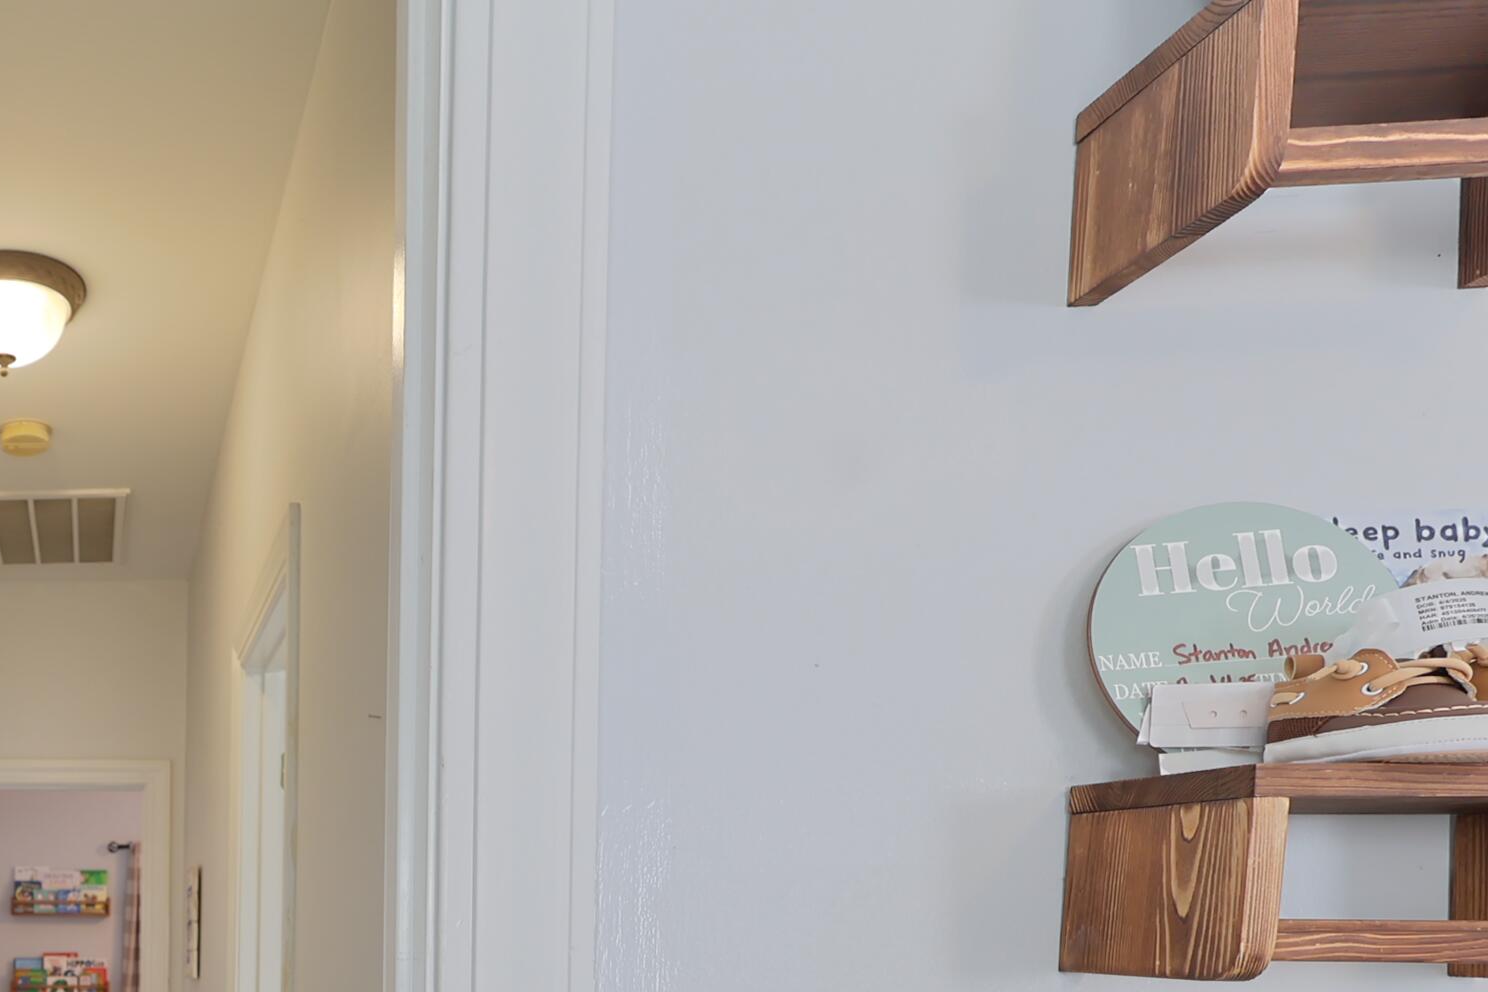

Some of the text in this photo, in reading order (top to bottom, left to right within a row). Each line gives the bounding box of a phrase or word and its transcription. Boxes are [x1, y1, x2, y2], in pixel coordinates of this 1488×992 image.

[1130, 528, 1338, 597] Hello
[1393, 548, 1422, 560] and
[1098, 651, 1163, 673] NAME
[1172, 643, 1257, 666] Stanton
[1114, 680, 1168, 700] DAT
